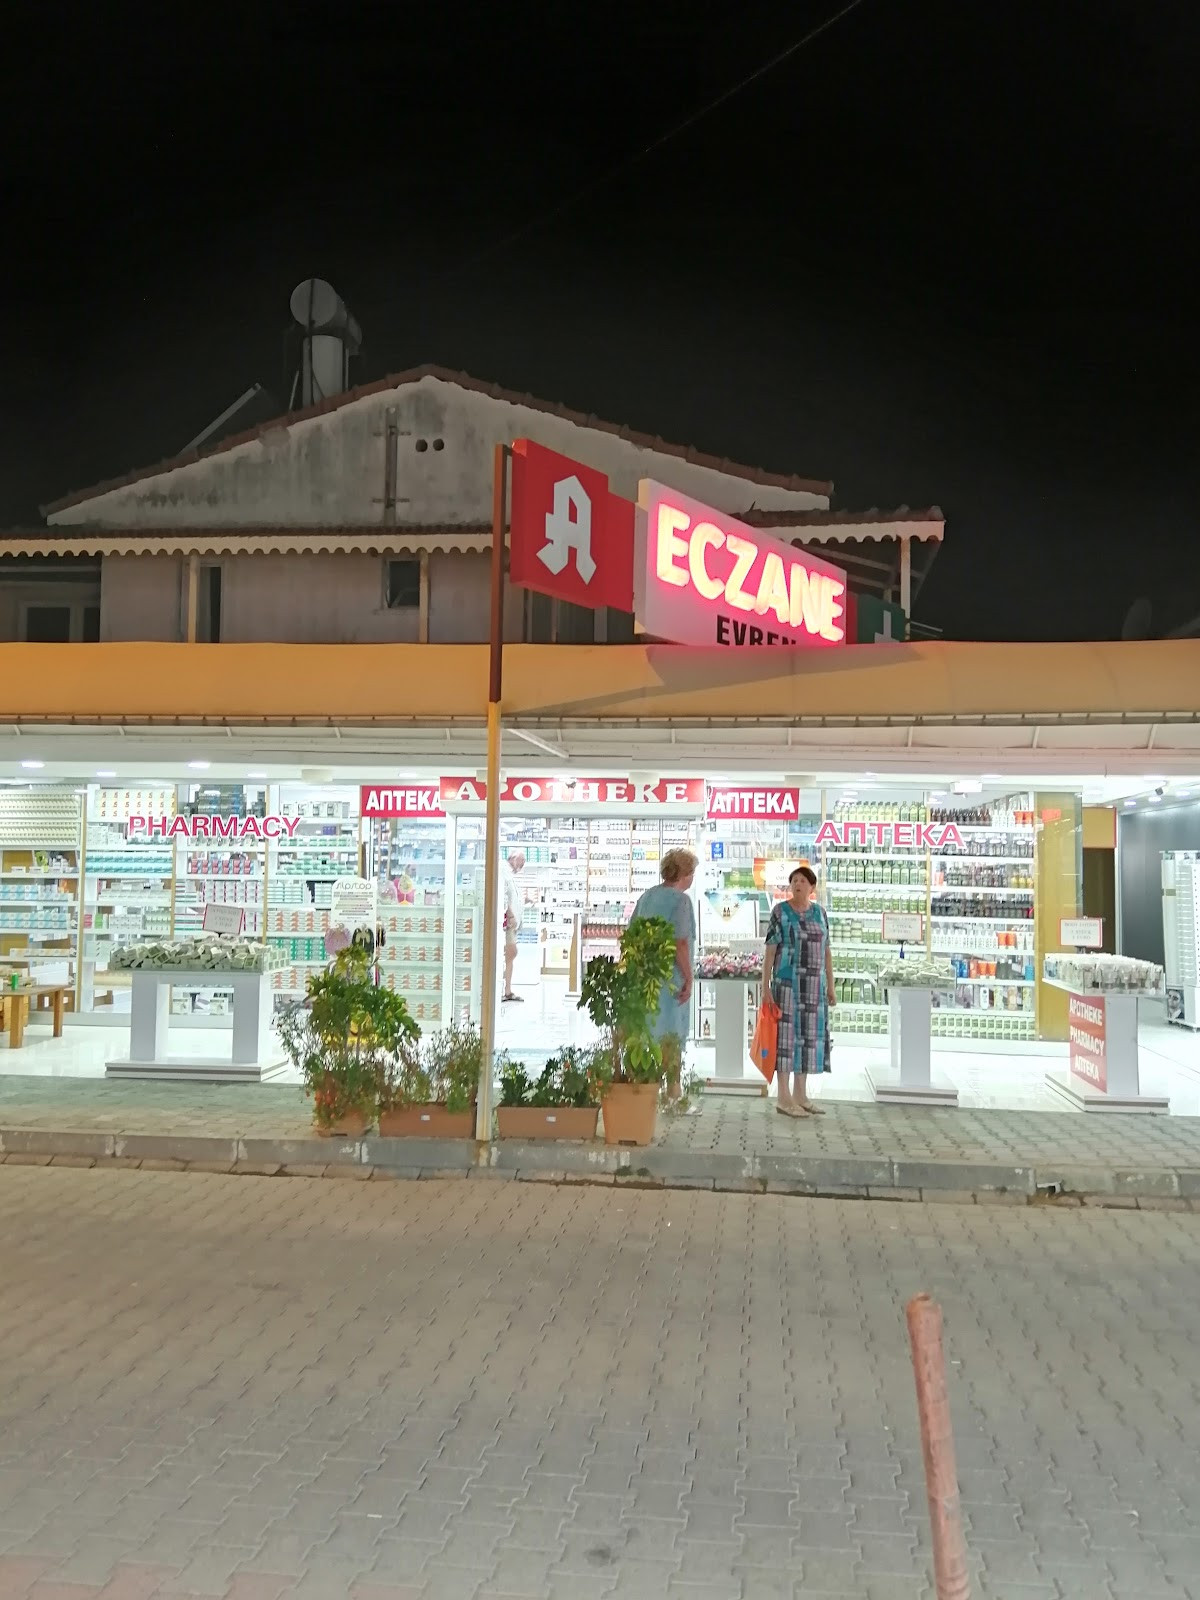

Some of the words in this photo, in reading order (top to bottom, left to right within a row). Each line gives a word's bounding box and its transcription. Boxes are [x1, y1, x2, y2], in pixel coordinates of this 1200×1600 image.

[656, 502, 845, 642] ECZANE
[365, 790, 441, 811] АПТЕКА
[711, 791, 795, 814] АПТЕКА
[128, 815, 301, 838] PHARMACY
[813, 821, 967, 849] АПТЕКА
[1069, 998, 1103, 1026] APOTHEKE
[1069, 1025, 1105, 1056] PHARMACY
[1074, 1054, 1100, 1082] АПТЕКА
